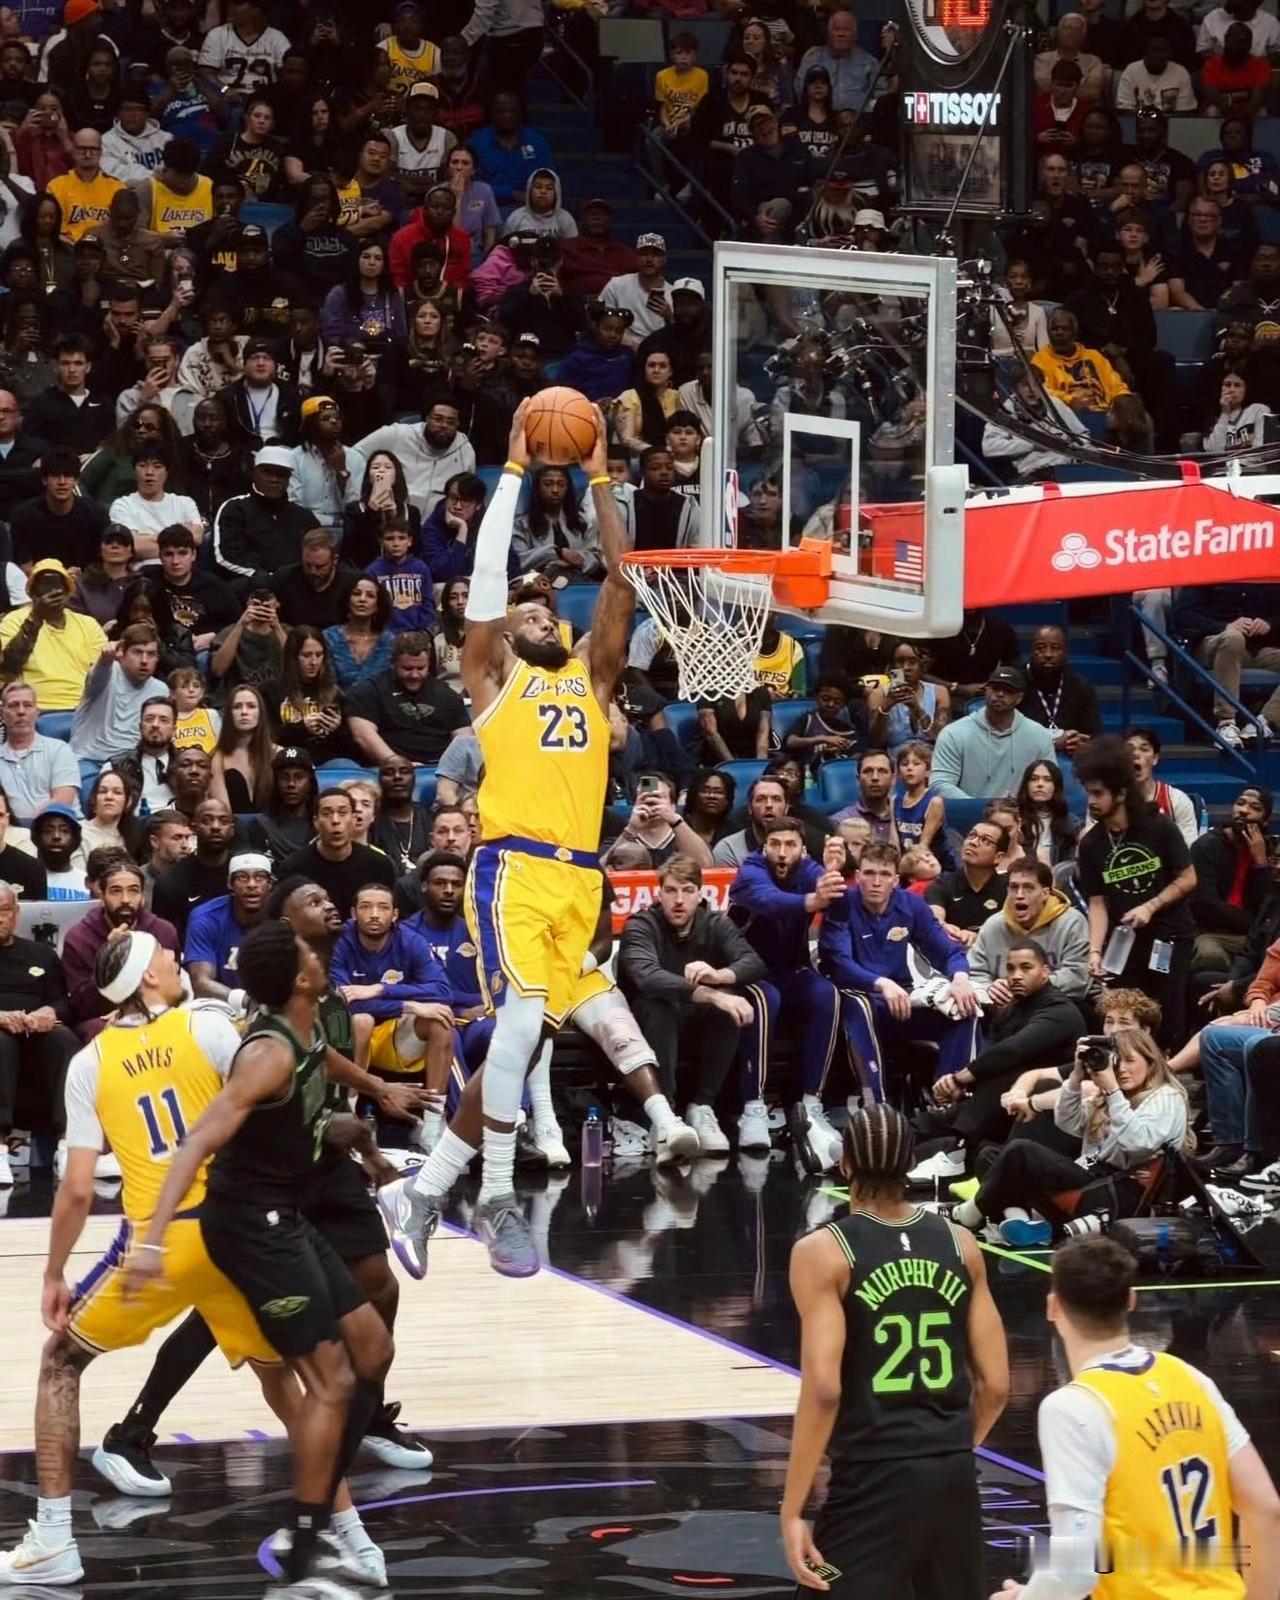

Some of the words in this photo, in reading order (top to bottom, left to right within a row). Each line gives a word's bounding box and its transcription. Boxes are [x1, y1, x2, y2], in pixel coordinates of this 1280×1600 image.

[161, 207, 206, 223] LAKERS
[538, 703, 588, 750] 23
[1107, 860, 1158, 882] PELICANS
[122, 1047, 173, 1078] HAYES
[137, 1087, 186, 1156] 11
[855, 1258, 940, 1311] MURPHY
[938, 1270, 967, 1306] III
[872, 1311, 954, 1393] 25
[1161, 1456, 1218, 1546] 12
